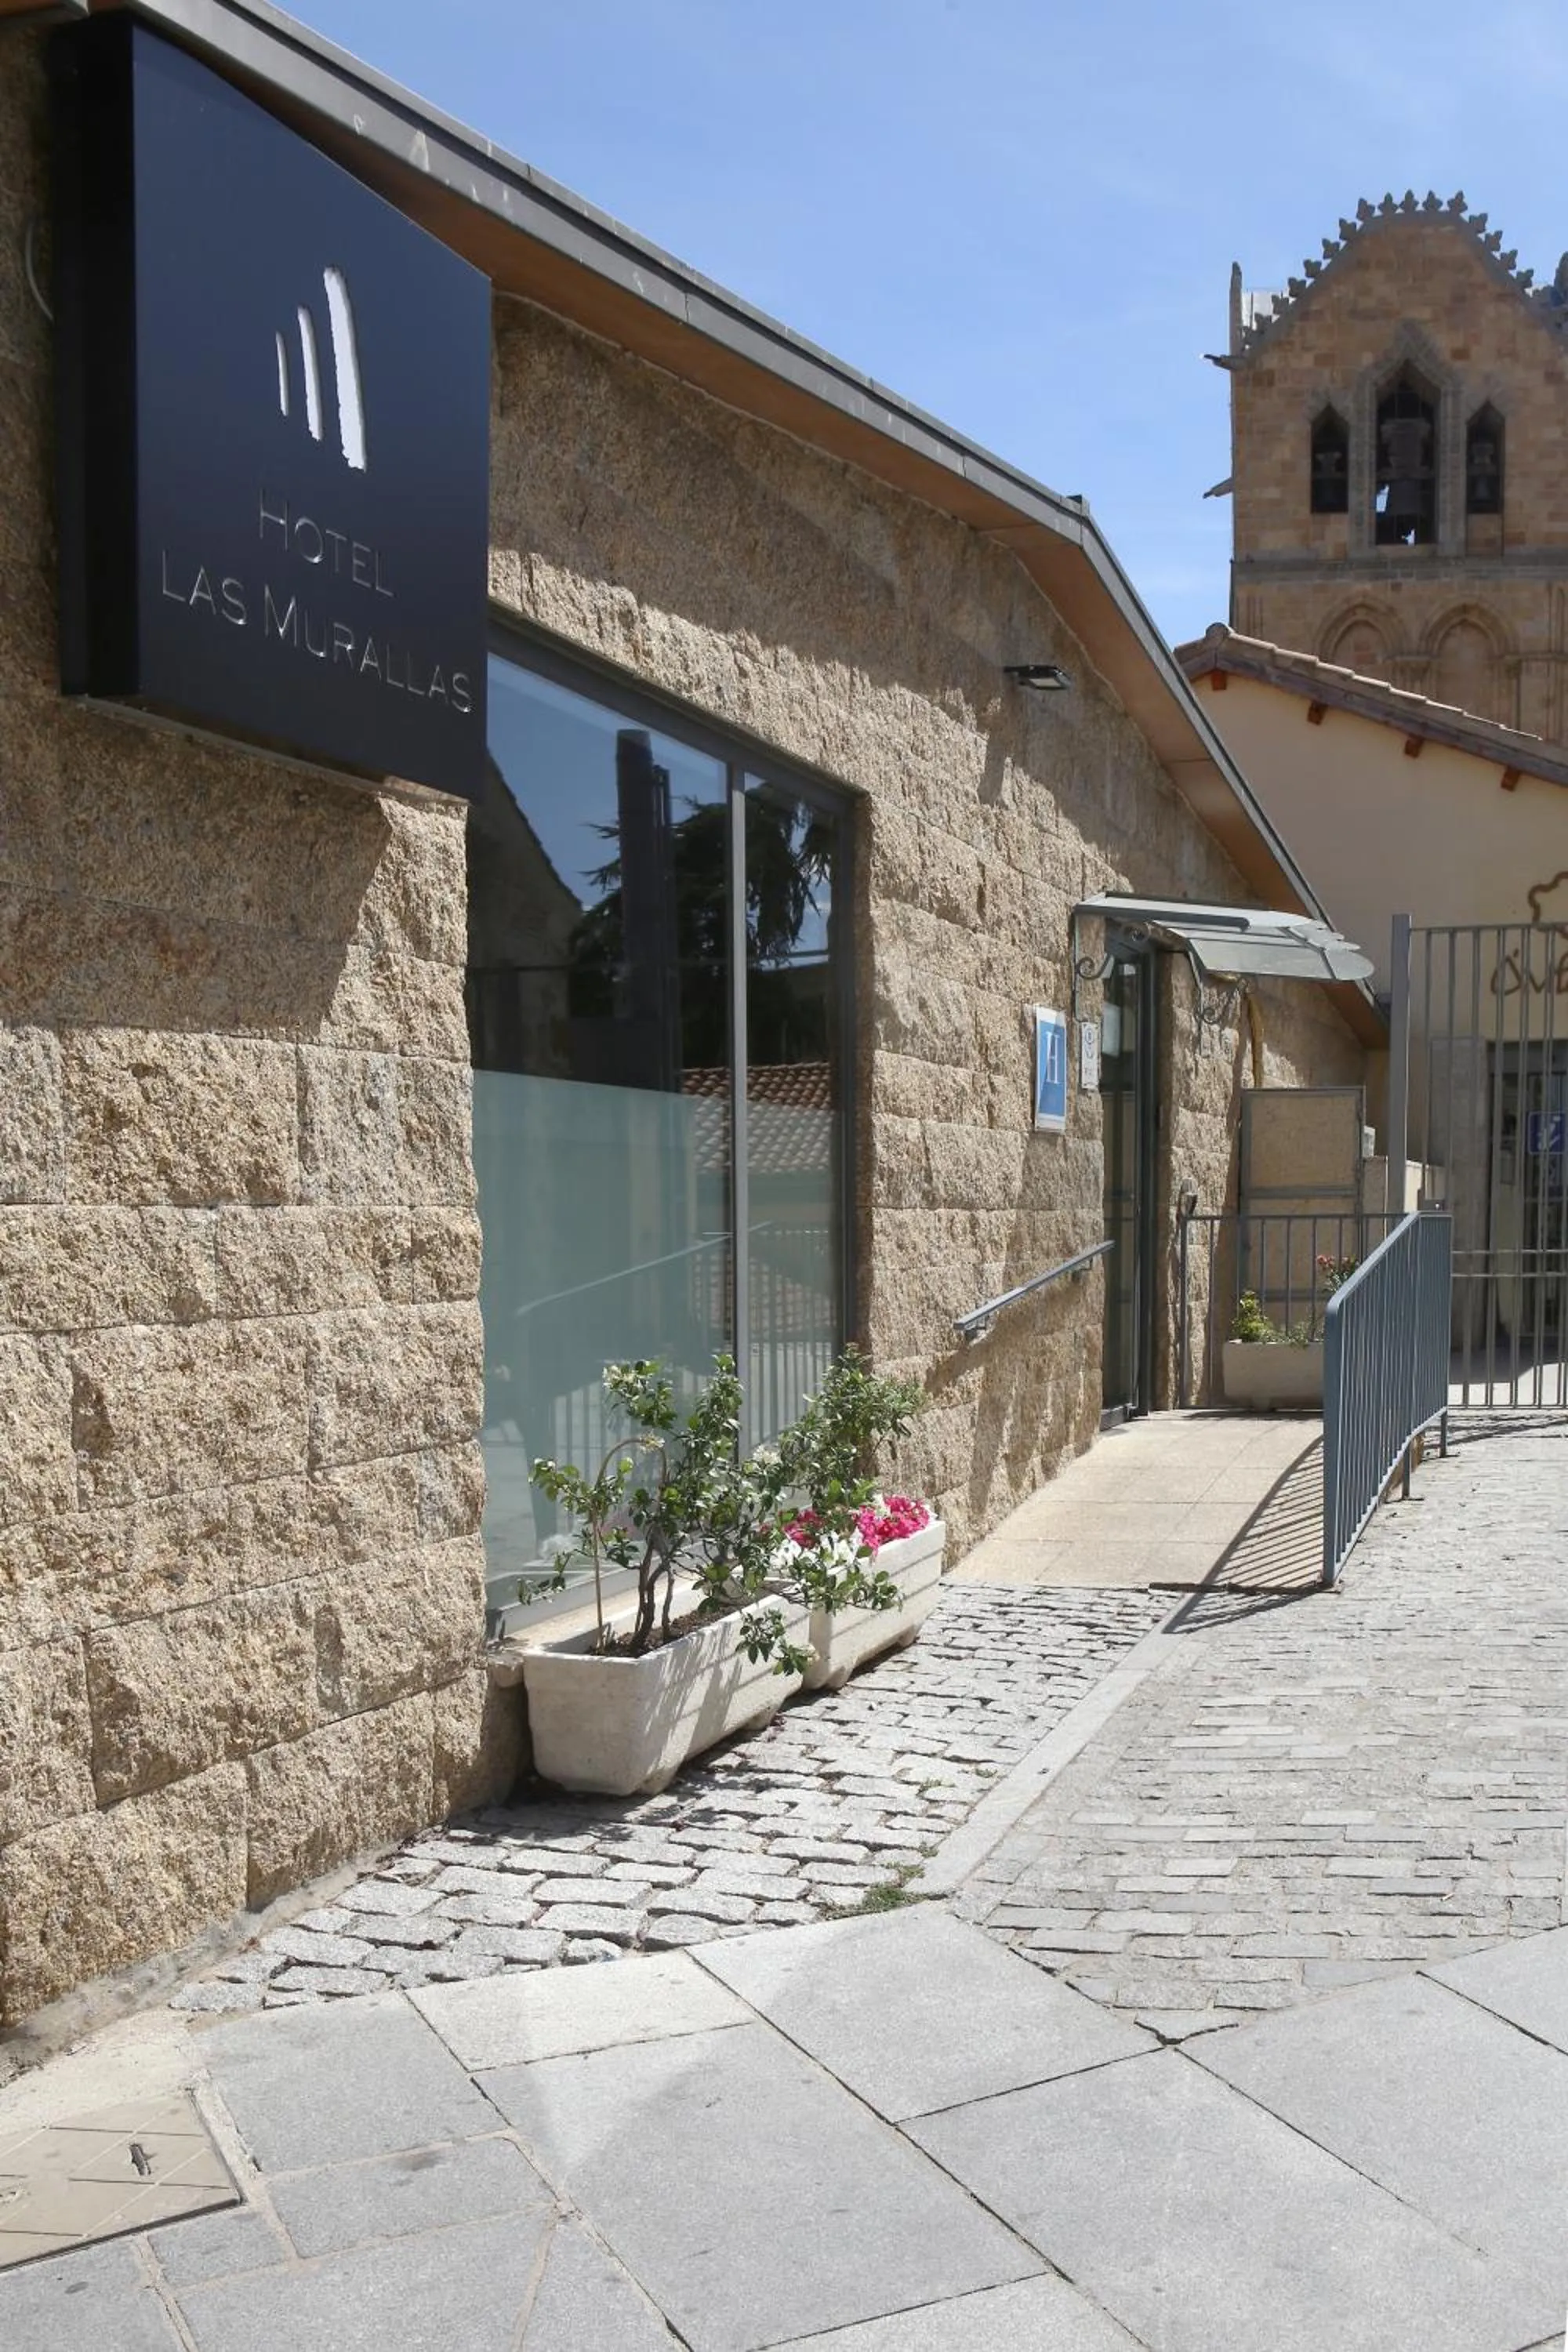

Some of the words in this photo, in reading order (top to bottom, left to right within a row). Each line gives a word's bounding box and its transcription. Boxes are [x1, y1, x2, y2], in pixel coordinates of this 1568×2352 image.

[260, 488, 394, 597] HOTEL
[162, 550, 248, 626] LAS
[264, 583, 474, 713] MURALLAS
[1045, 1030, 1061, 1084] H
